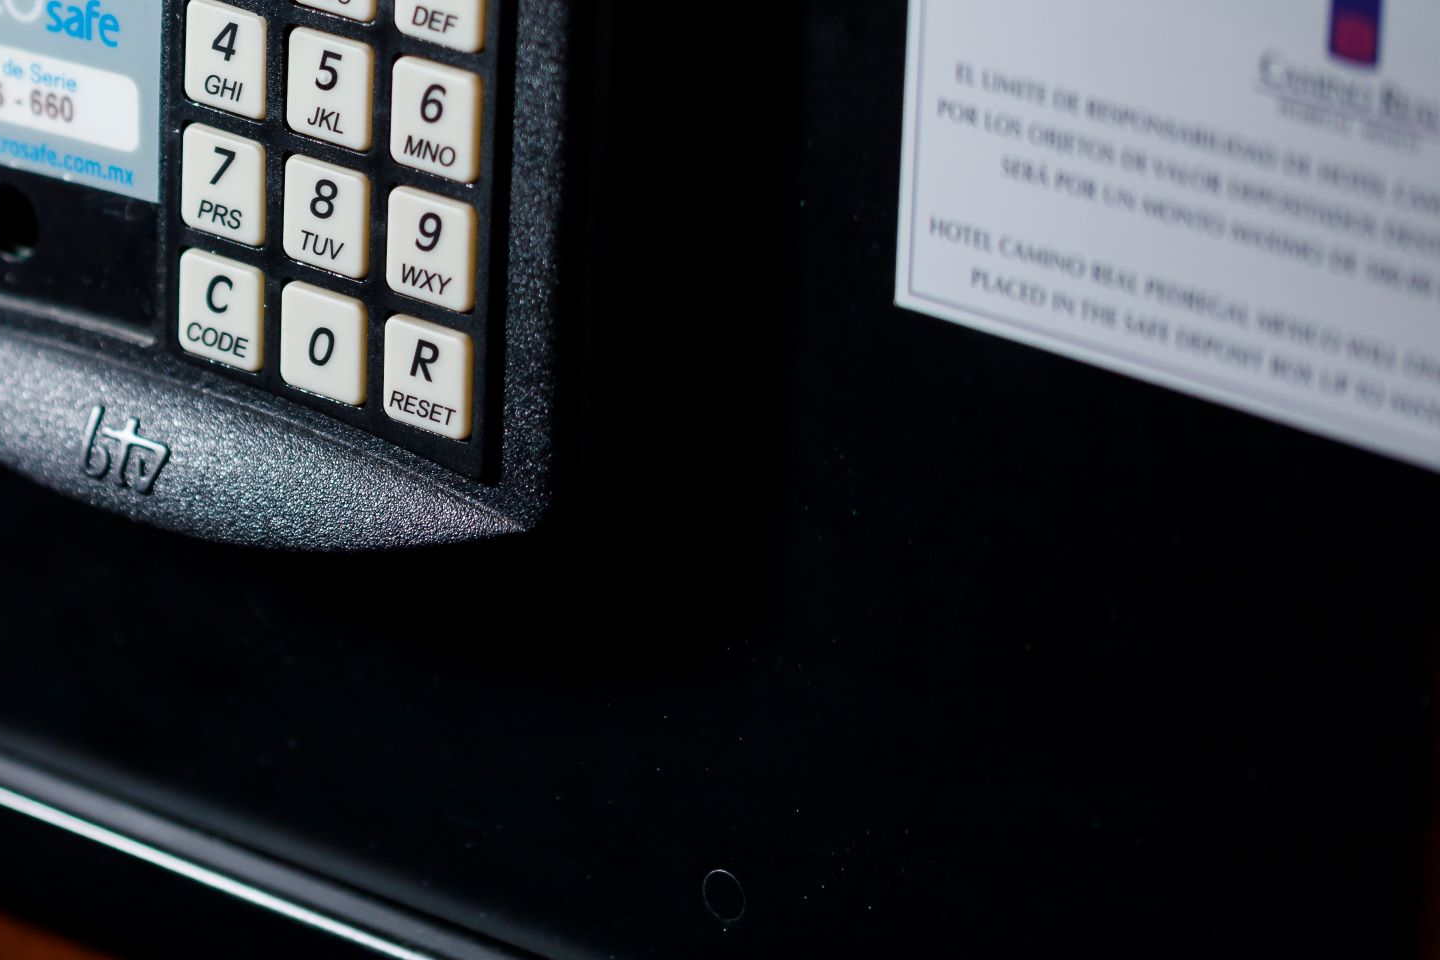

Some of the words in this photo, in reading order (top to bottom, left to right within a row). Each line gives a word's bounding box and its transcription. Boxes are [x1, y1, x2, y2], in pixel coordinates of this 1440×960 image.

[46, 0, 120, 48] safe
[412, 6, 458, 34] DEF
[211, 22, 238, 62] 4
[3, 58, 24, 80] de
[29, 63, 77, 93] Serie
[204, 74, 244, 102] GHI
[315, 50, 343, 91] 5
[30, 88, 75, 124] 660
[307, 106, 344, 134] JKL
[420, 83, 448, 124] 6
[937, 96, 978, 129] POR
[984, 108, 1021, 139] LOS
[209, 147, 236, 185] 7
[403, 135, 456, 167] MNO
[198, 200, 243, 230] PRS
[309, 179, 338, 219] 8
[300, 230, 344, 260] TUV
[415, 212, 442, 252] 9
[928, 214, 993, 254] HOTEL
[998, 233, 1087, 281] CAMINO
[205, 275, 233, 313] C
[401, 263, 452, 295] WXY
[970, 265, 1047, 310] PLACED
[1051, 288, 1075, 316] IN
[1079, 297, 1116, 330] THE
[186, 322, 249, 358] CODE
[308, 327, 335, 366] 0
[409, 339, 439, 382] R
[389, 391, 457, 426] RESET
